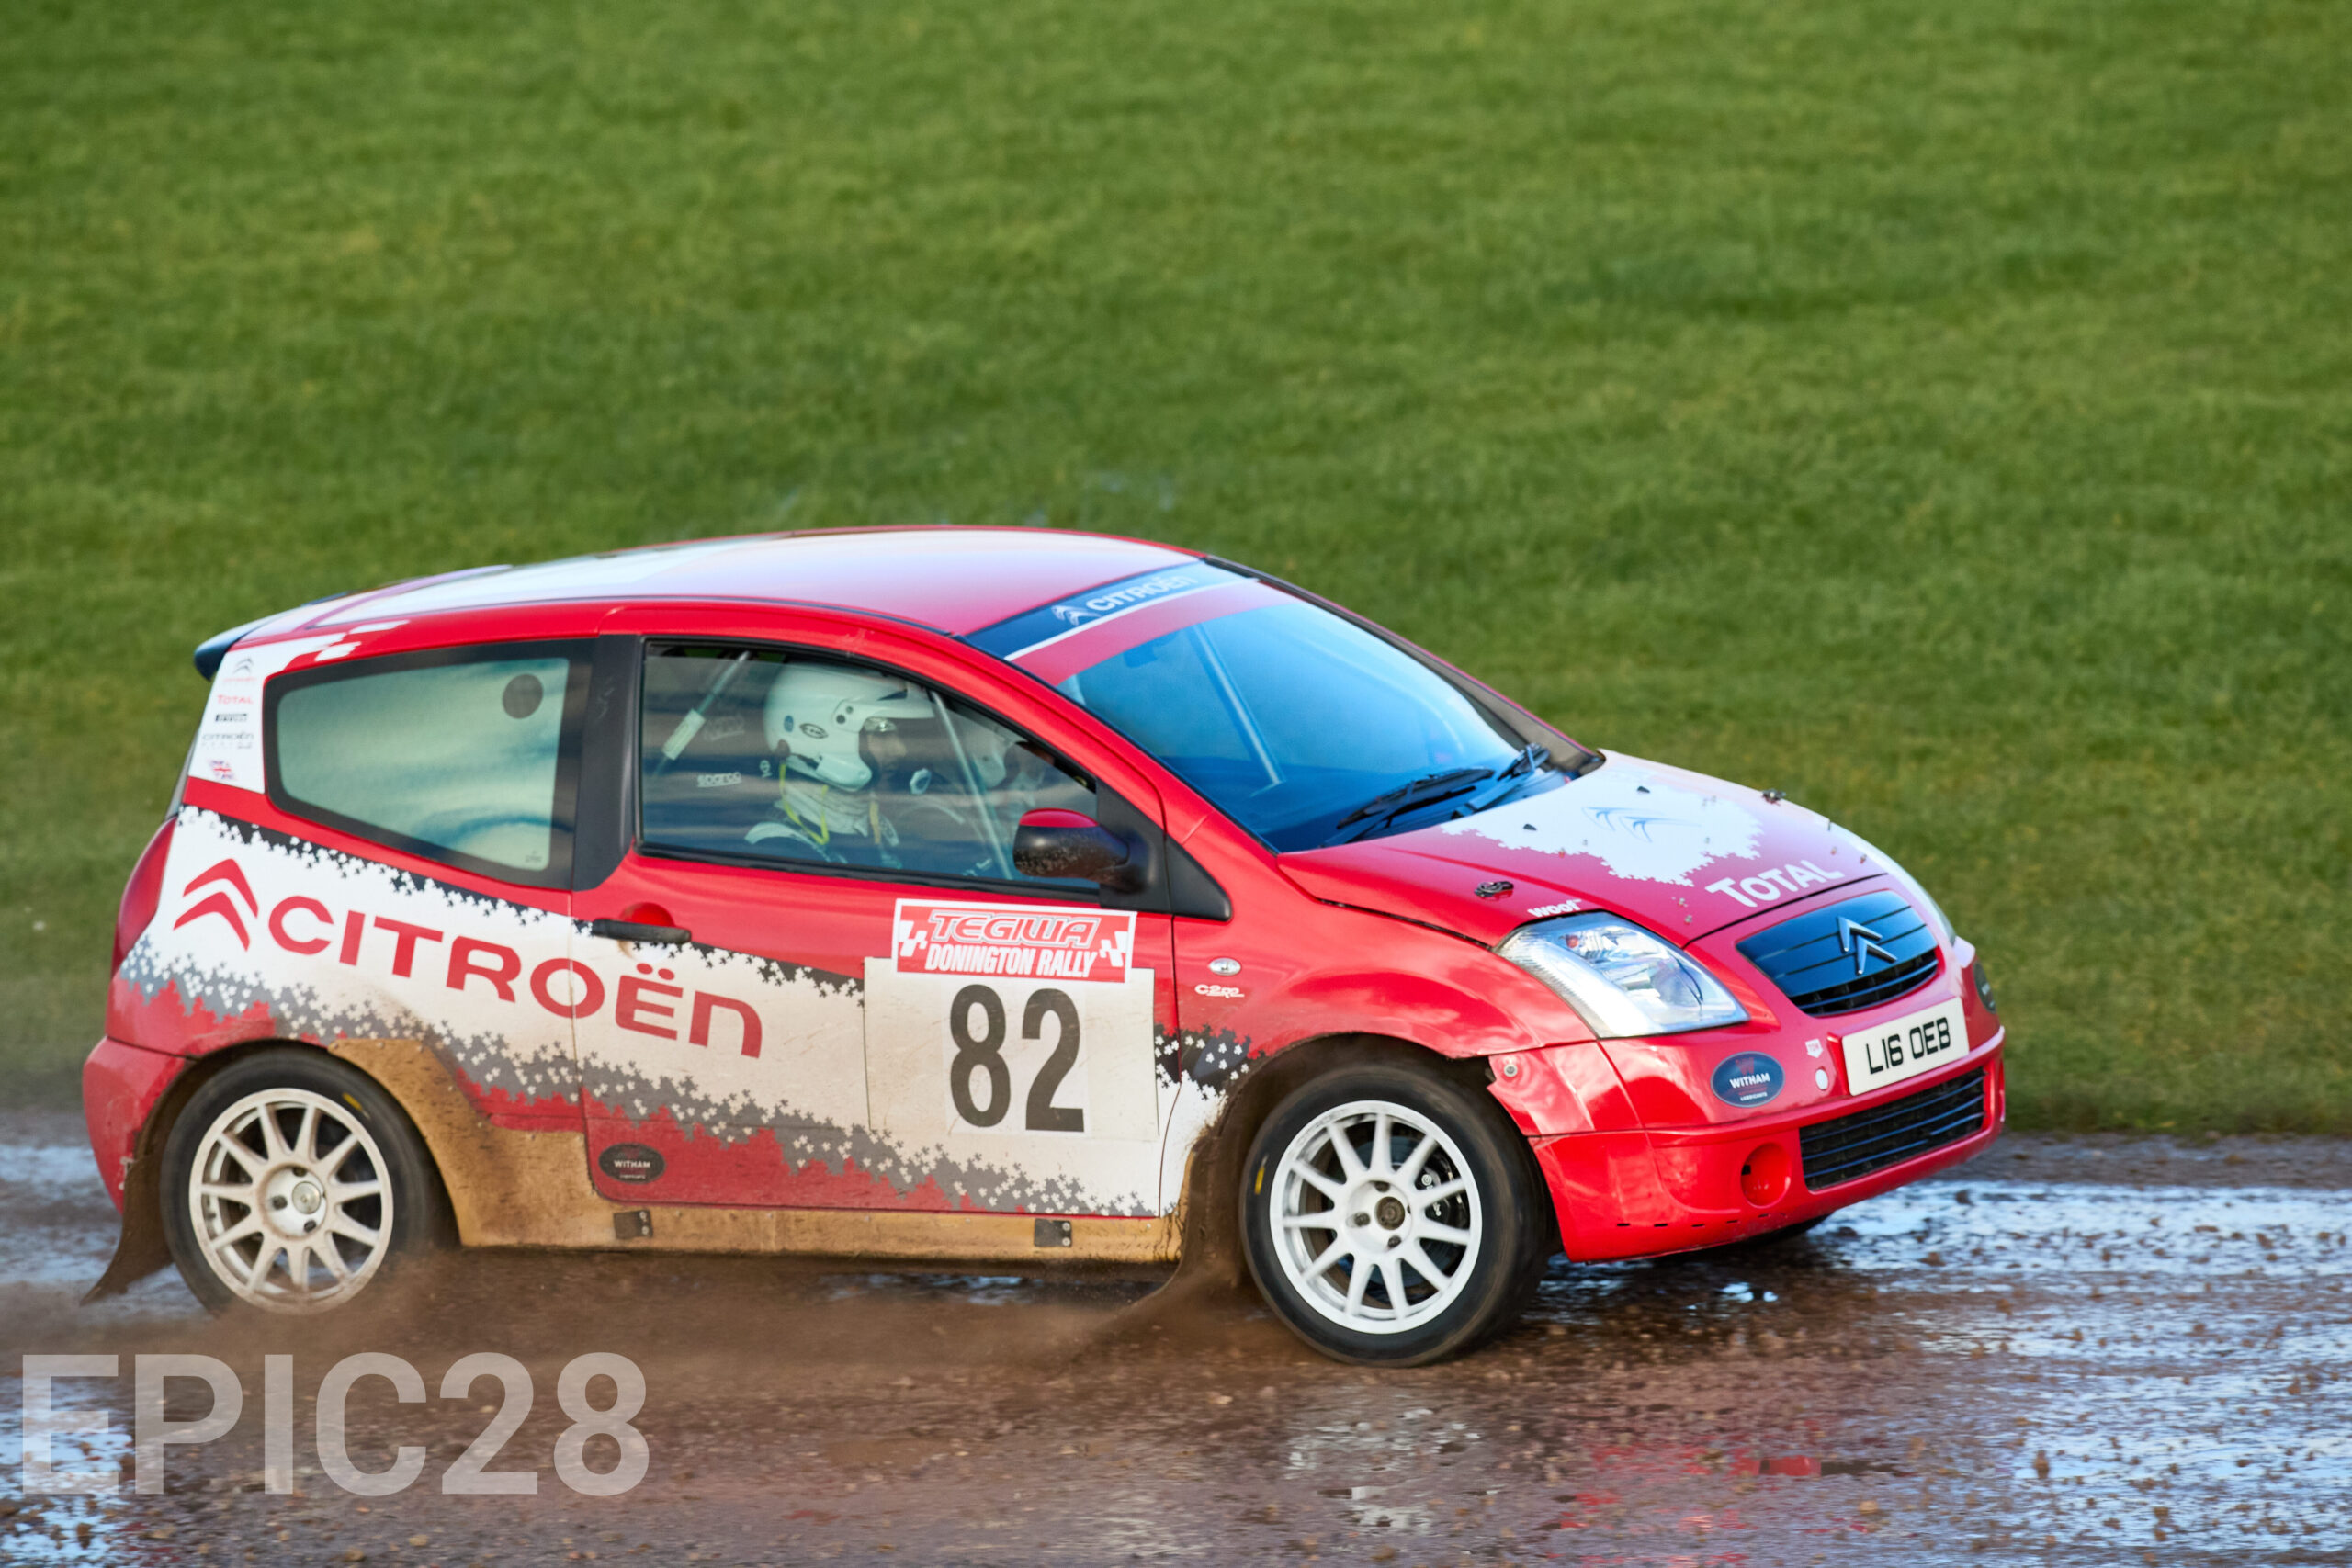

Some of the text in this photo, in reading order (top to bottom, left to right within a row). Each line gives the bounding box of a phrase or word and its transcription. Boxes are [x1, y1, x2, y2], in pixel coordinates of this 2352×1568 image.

[1704, 857, 1845, 908] TOTAL
[928, 909, 1101, 949] TEGIWA
[925, 943, 1098, 977] DONINGTON RALLY
[950, 984, 1084, 1133] 82
[1866, 1017, 1951, 1075] L16 OEB
[1730, 1073, 1770, 1089] WITHAM
[613, 1160, 650, 1168] WITHAM
